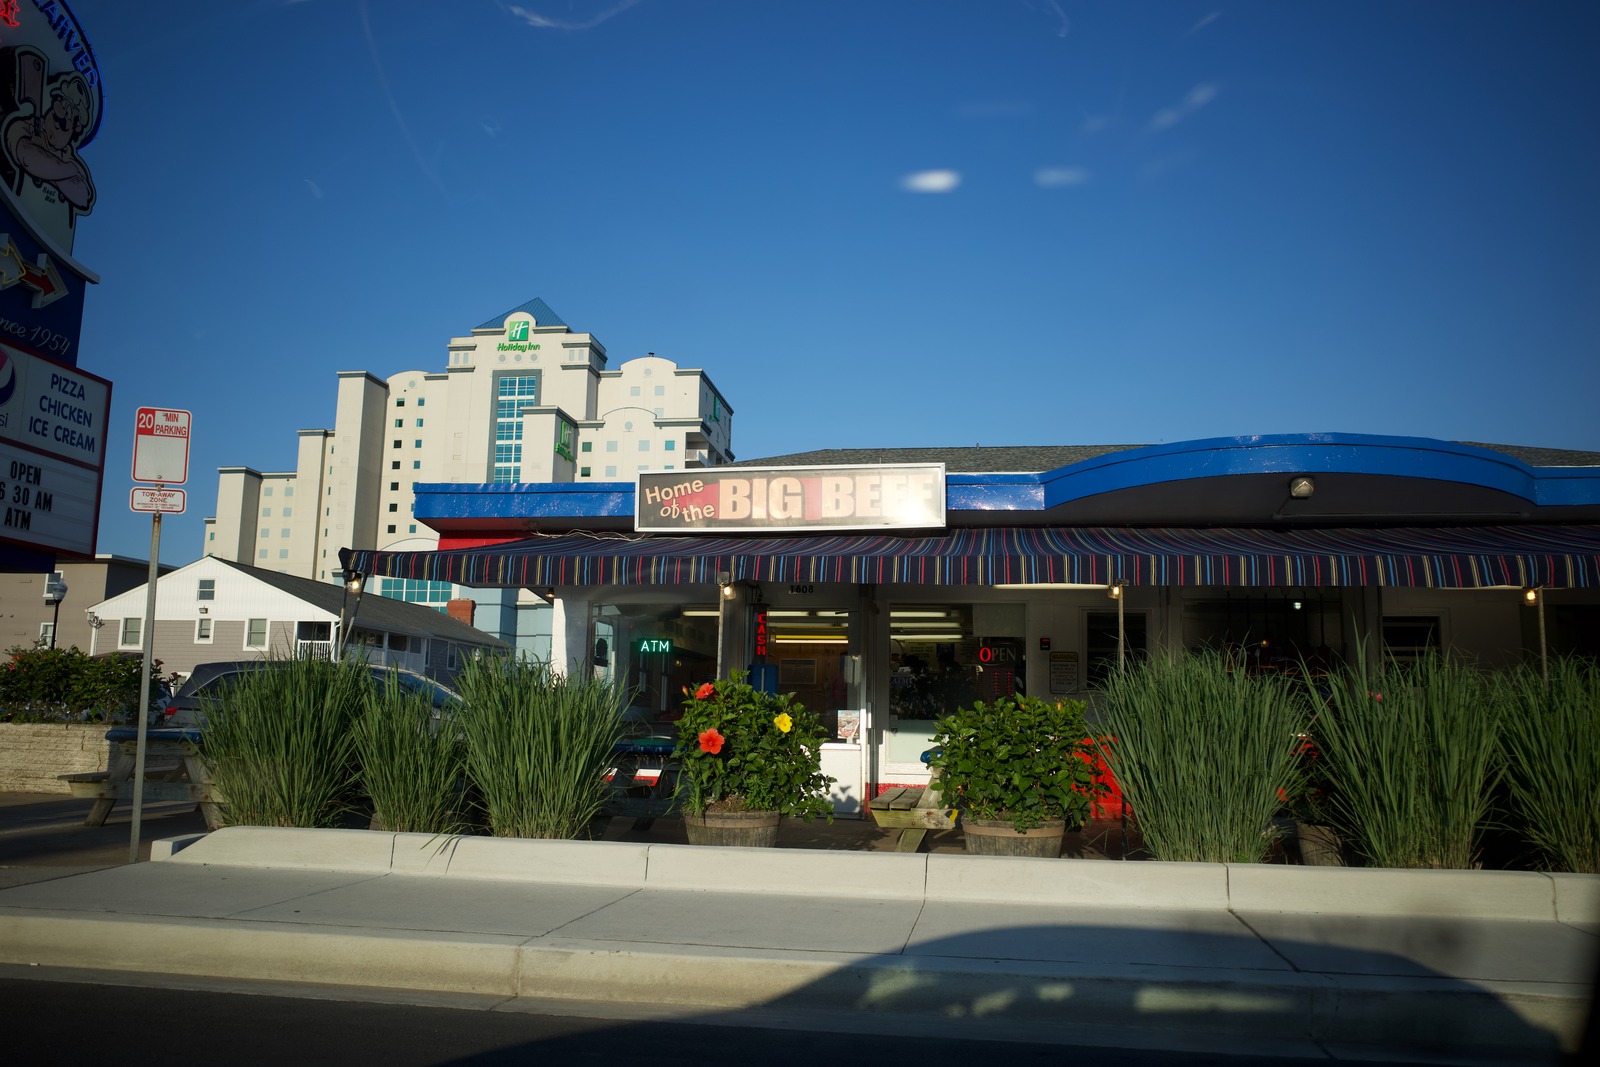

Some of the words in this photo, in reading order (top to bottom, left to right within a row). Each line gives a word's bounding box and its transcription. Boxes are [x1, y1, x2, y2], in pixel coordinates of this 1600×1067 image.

[36, 0, 98, 87] ARVED
[30, 325, 71, 356] 1954
[497, 342, 527, 353] Holiday
[528, 341, 541, 351] Inn
[50, 373, 86, 401] PIZZA
[39, 395, 93, 428] CHICKEN
[138, 413, 154, 429] 20
[165, 412, 179, 423] MIN
[29, 416, 49, 438] ICE
[54, 425, 95, 453] CREAM
[155, 424, 187, 436] PARKING
[10, 460, 42, 486] OPEN
[13, 485, 30, 506] 30
[34, 491, 53, 512] AM
[645, 479, 704, 505] Home
[719, 477, 802, 520] BIG
[821, 474, 934, 518] BEEF
[4, 507, 31, 530] ATM
[660, 498, 680, 519] of
[682, 504, 716, 523] the
[790, 585, 814, 594] 1608
[640, 639, 670, 653] ATM
[756, 613, 767, 657] CASH
[979, 646, 1016, 663] OPEN
